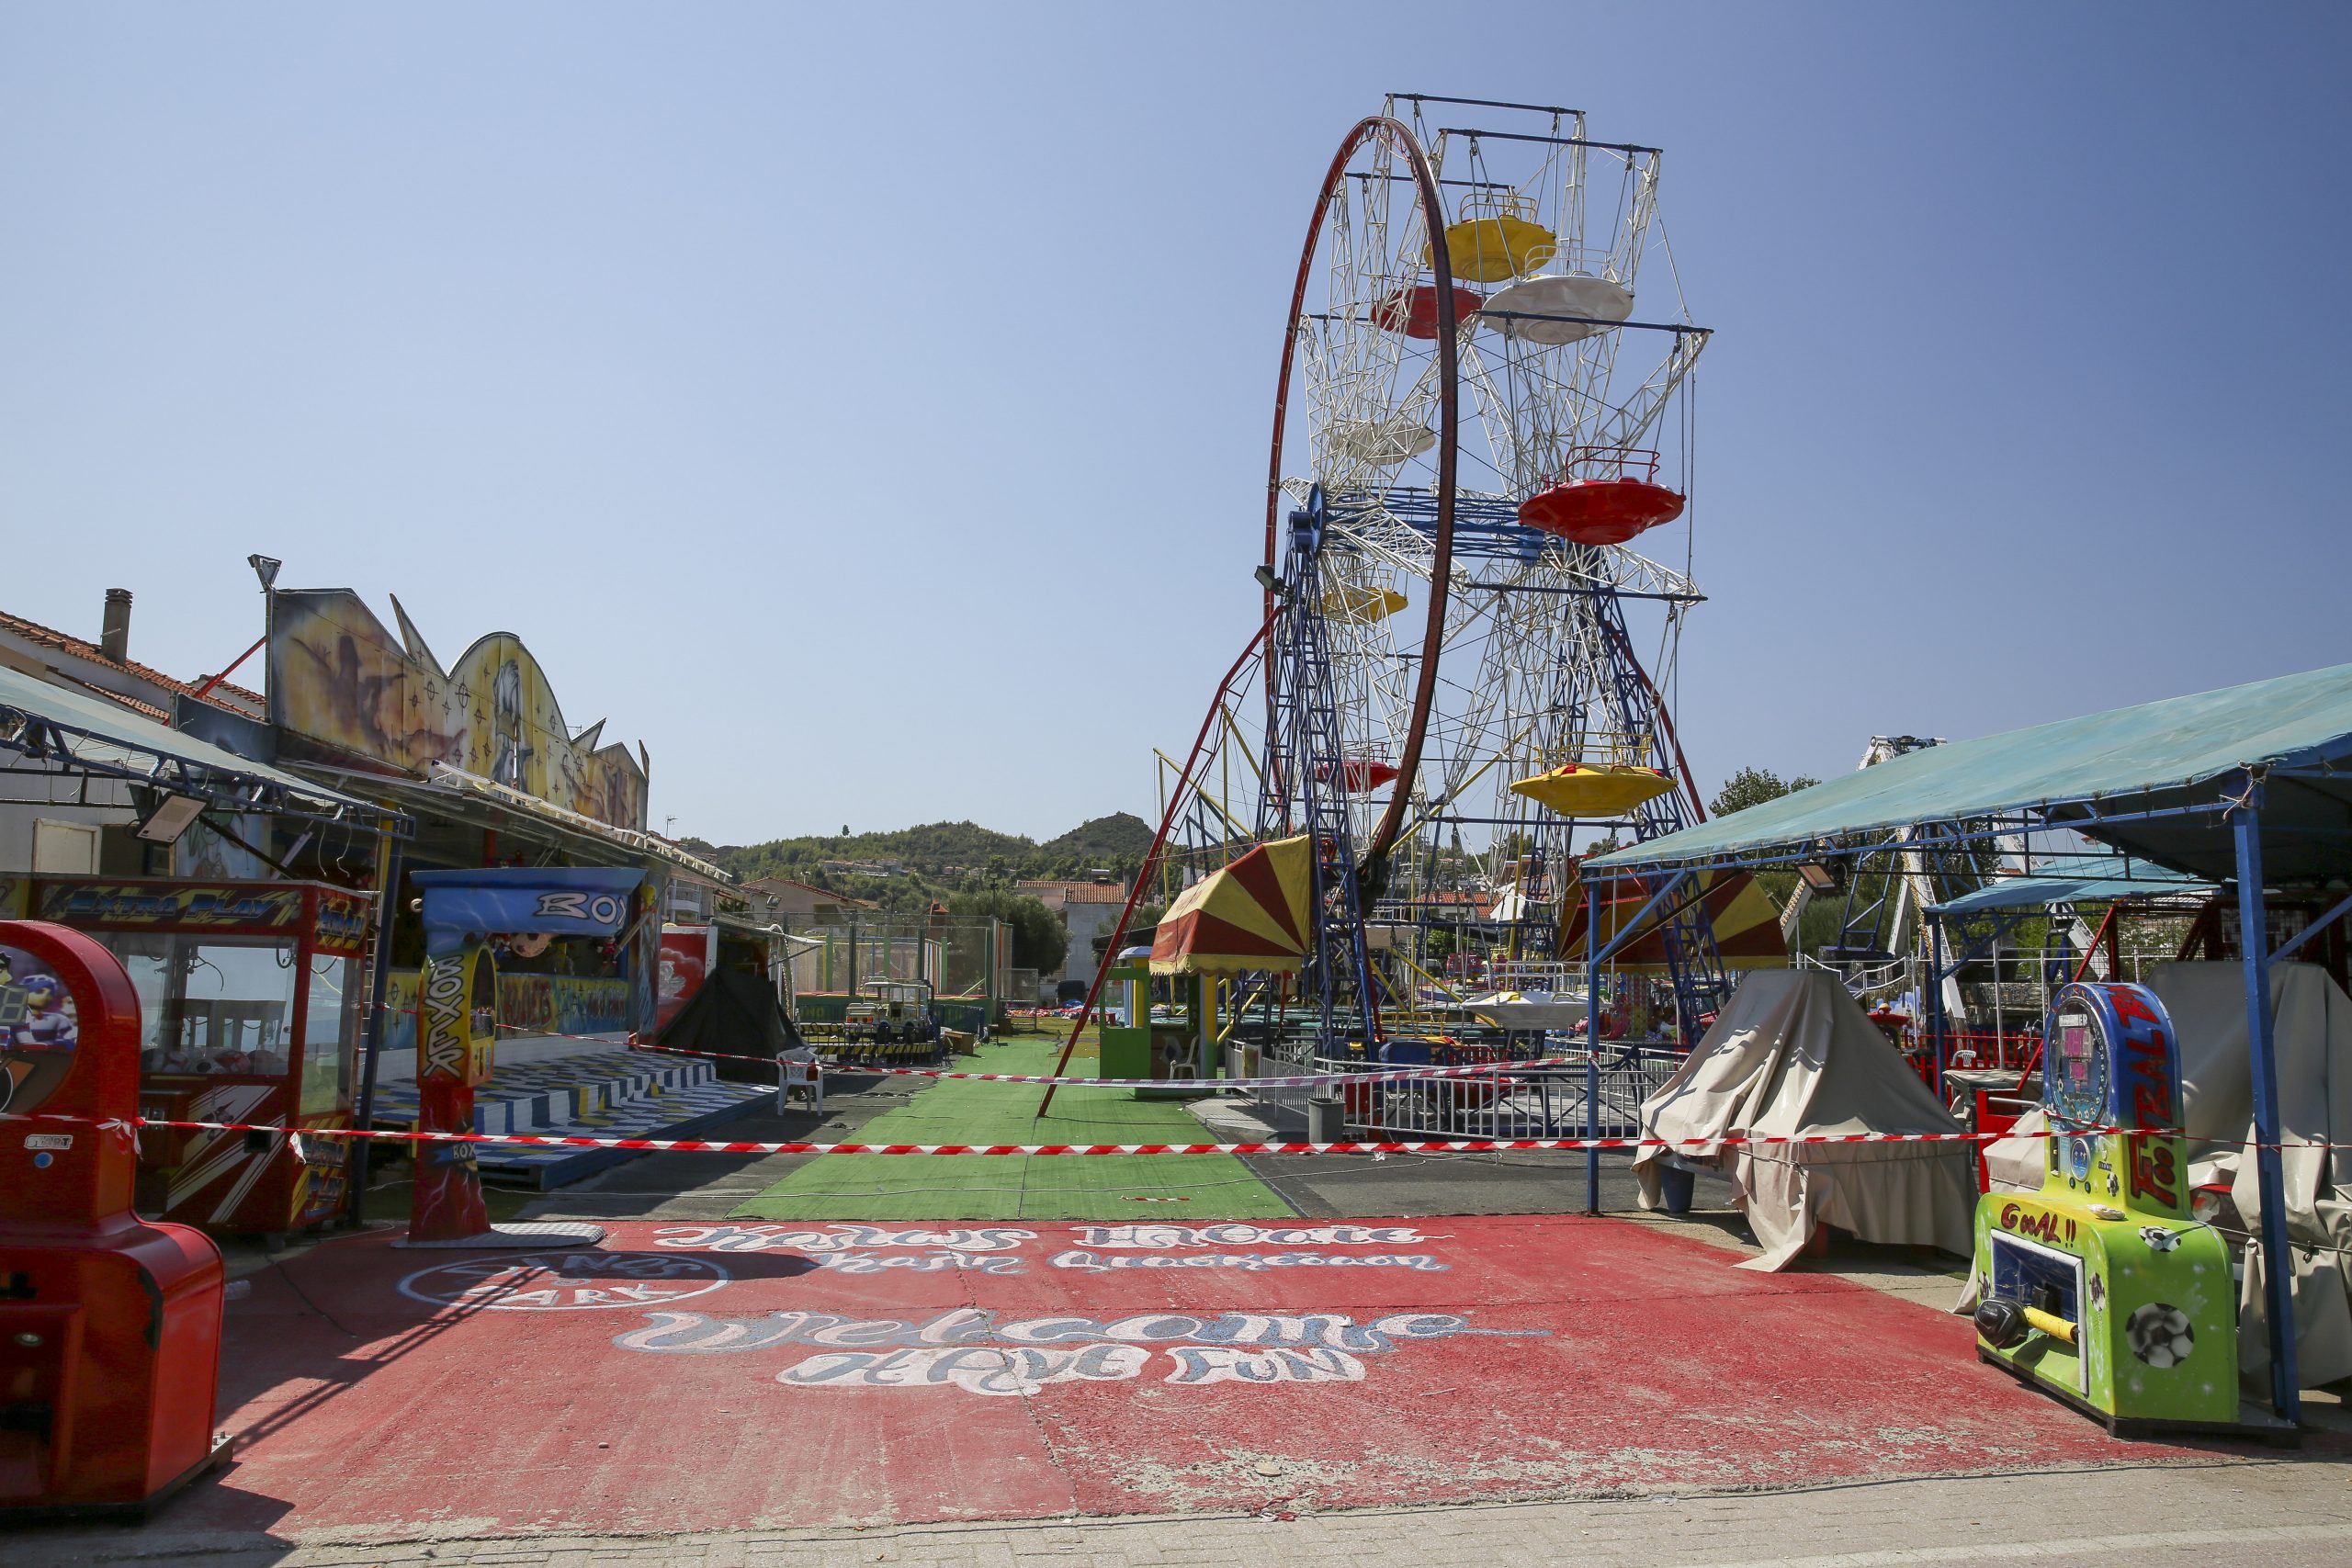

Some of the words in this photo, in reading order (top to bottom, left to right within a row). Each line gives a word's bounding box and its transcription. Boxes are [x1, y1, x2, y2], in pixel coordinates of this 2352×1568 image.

[422, 954, 466, 1078] BOXER
[452, 1142, 477, 1160] BOX
[612, 1308, 1553, 1354] Welcome
